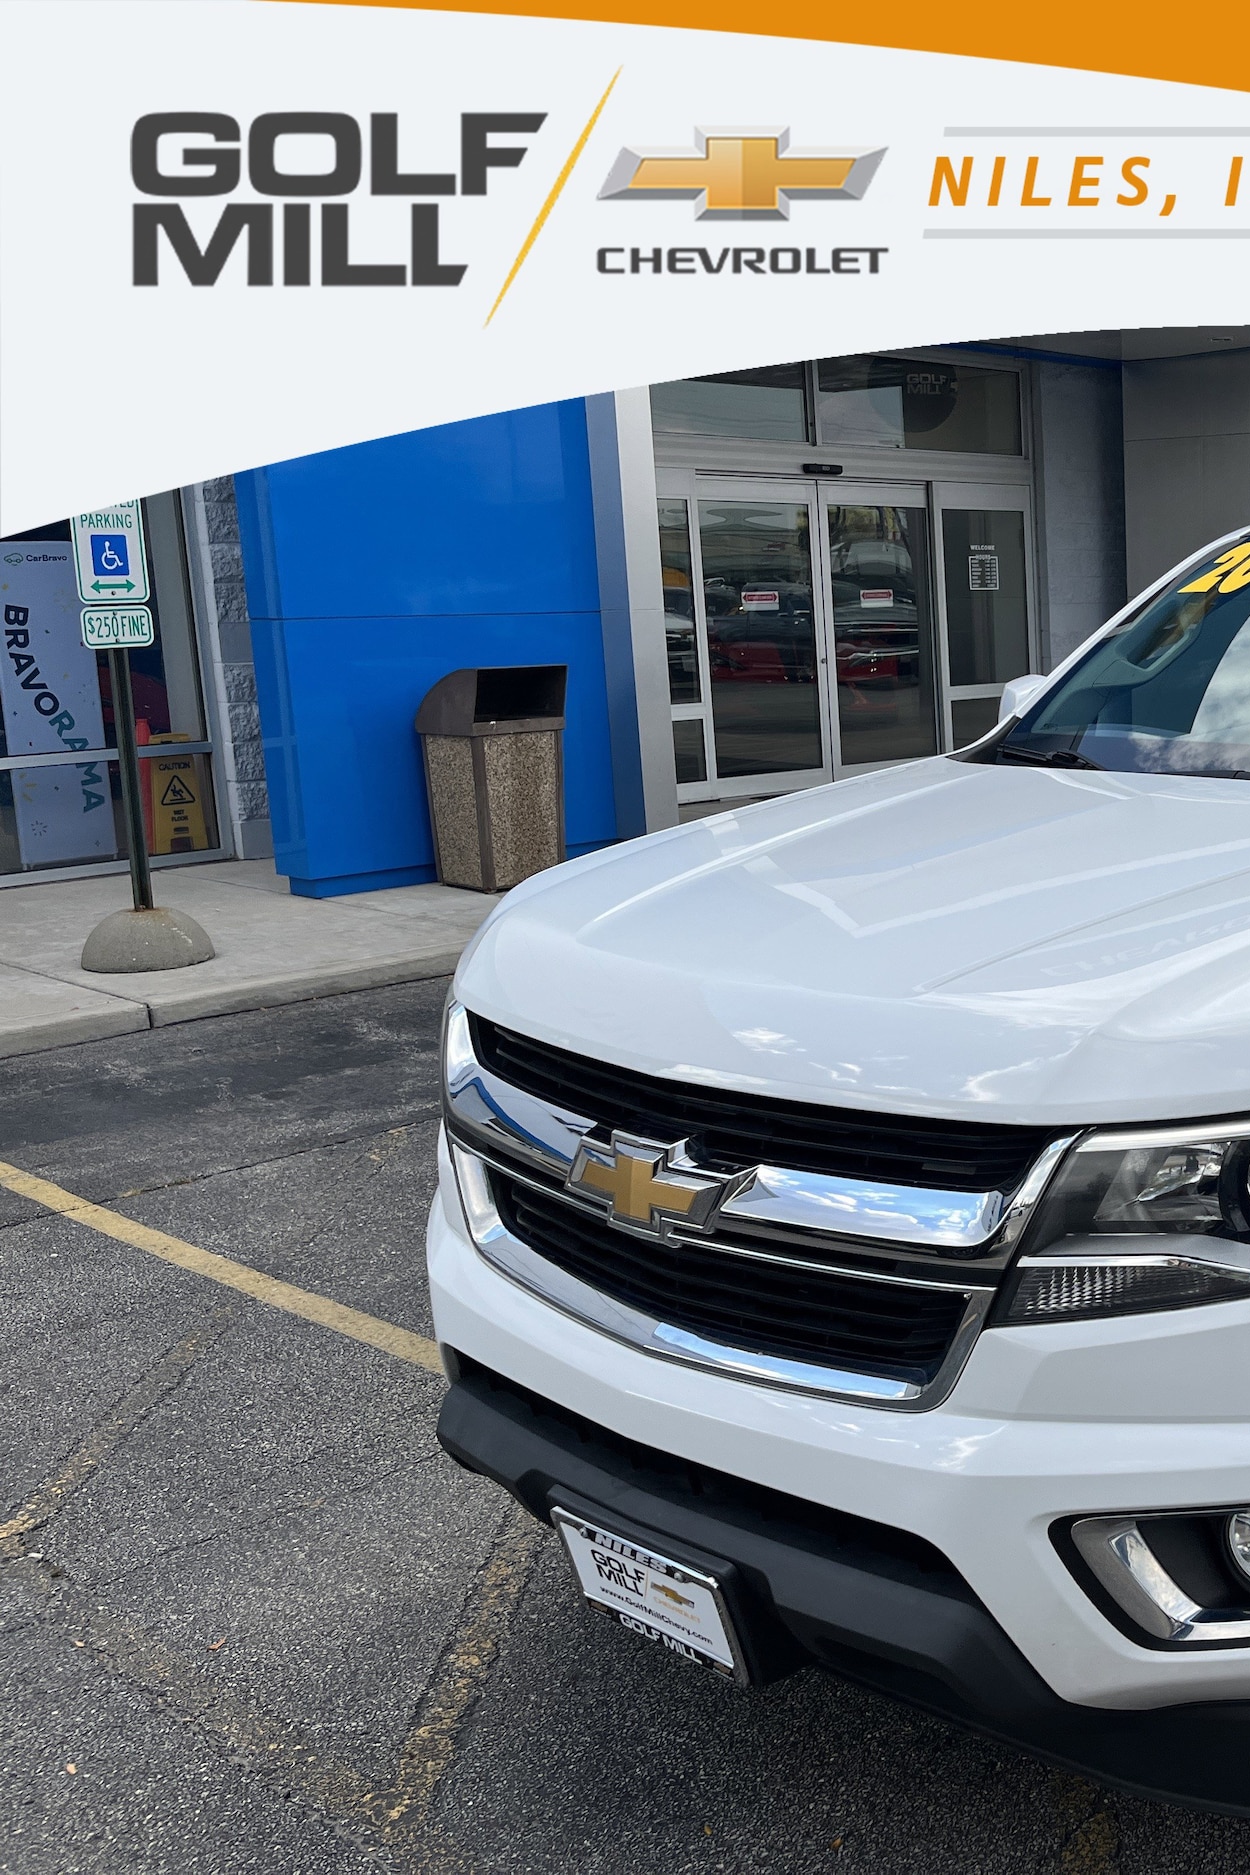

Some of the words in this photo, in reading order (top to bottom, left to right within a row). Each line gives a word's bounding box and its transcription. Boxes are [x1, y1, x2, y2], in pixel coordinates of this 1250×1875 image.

[906, 373, 947, 385] GOLF
[907, 384, 942, 395] MILL
[80, 512, 133, 529] PARKING
[25, 554, 68, 562] CarBravo
[87, 615, 120, 639] $250
[120, 614, 148, 637] FINE
[158, 761, 191, 771] CAUTION
[594, 1531, 667, 1575] NILES
[590, 1549, 646, 1584] GOLF
[595, 1563, 644, 1597] MILL
[619, 1612, 661, 1642] GOLF
[661, 1634, 703, 1665] MILL
